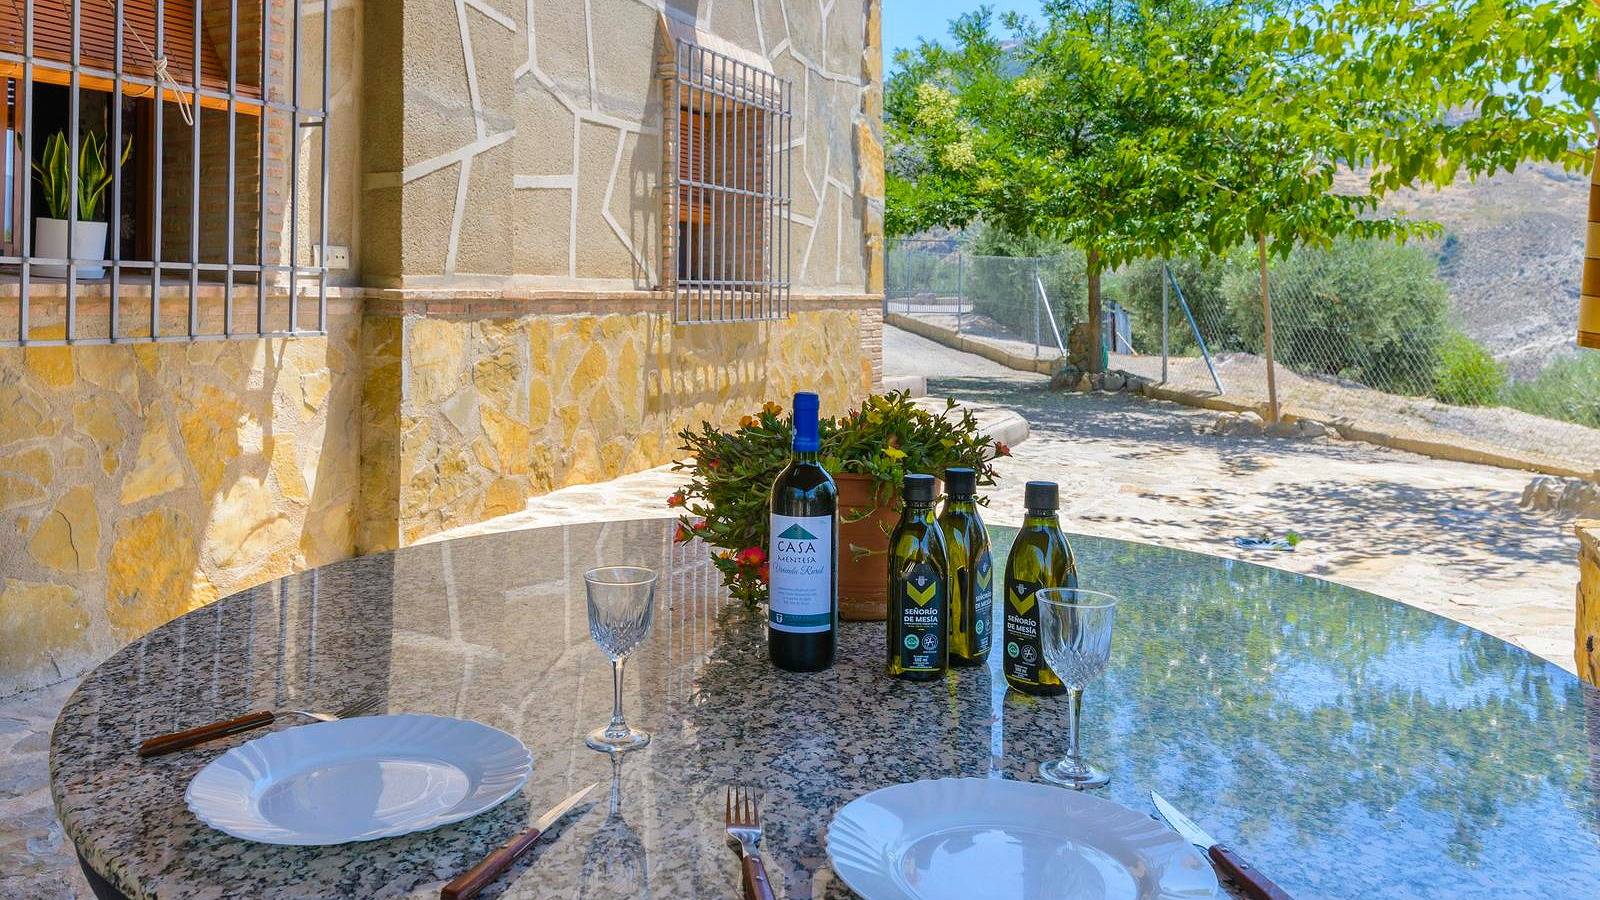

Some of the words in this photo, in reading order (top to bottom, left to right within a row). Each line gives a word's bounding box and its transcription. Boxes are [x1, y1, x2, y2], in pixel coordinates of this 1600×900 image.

[777, 540, 816, 554] CASA
[904, 607, 938, 616] SEÑORÍO
[915, 615, 938, 623] MESÍA
[1007, 614, 1037, 627] SEÑORÍO
[1007, 622, 1015, 630] DE
[1016, 624, 1037, 635] MESÍA
